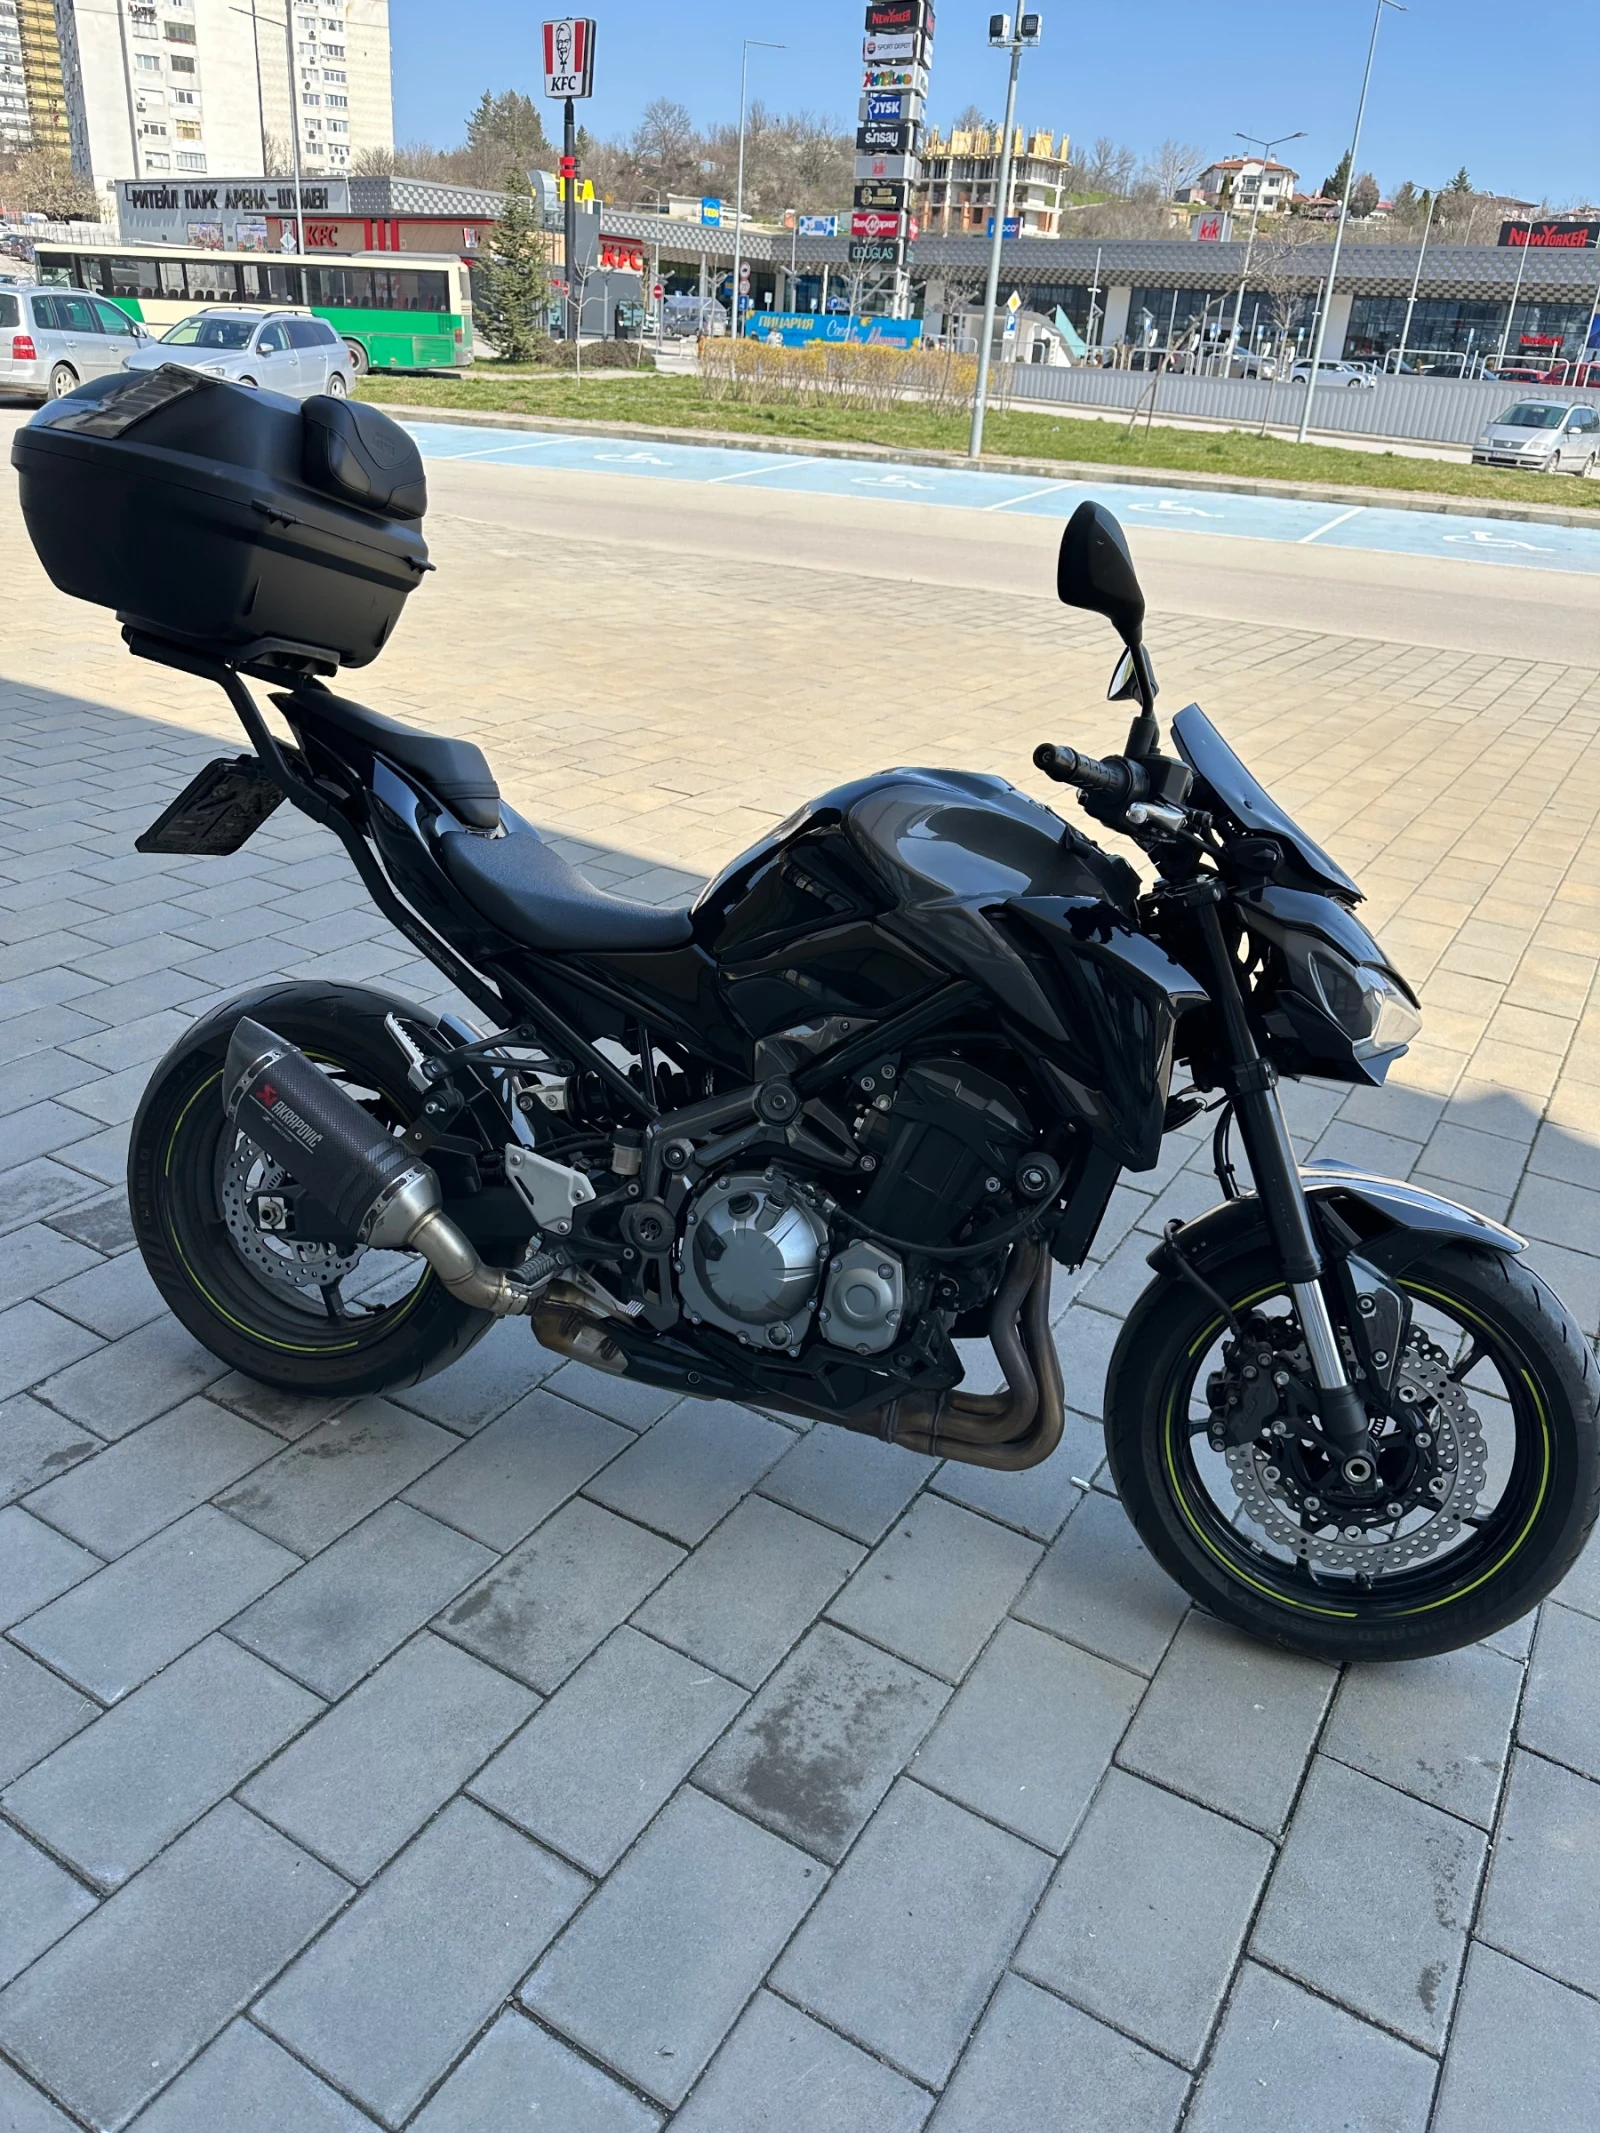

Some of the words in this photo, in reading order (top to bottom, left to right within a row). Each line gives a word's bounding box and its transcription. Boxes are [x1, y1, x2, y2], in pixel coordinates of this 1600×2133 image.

[877, 43, 893, 51] SPORT
[894, 42, 911, 50] DEPOT
[550, 75, 577, 92] KFC
[873, 101, 900, 114] JYSK
[864, 129, 899, 147] sinsay
[131, 185, 180, 209] РИТЕЙЛ
[185, 188, 219, 209] ПАРК
[305, 226, 338, 247] KFC
[600, 243, 644, 271] KFC
[852, 246, 894, 259] DOUGLAS
[1008, 316, 1015, 328] P
[271, 1100, 324, 1148] AKRAPOVIČ
